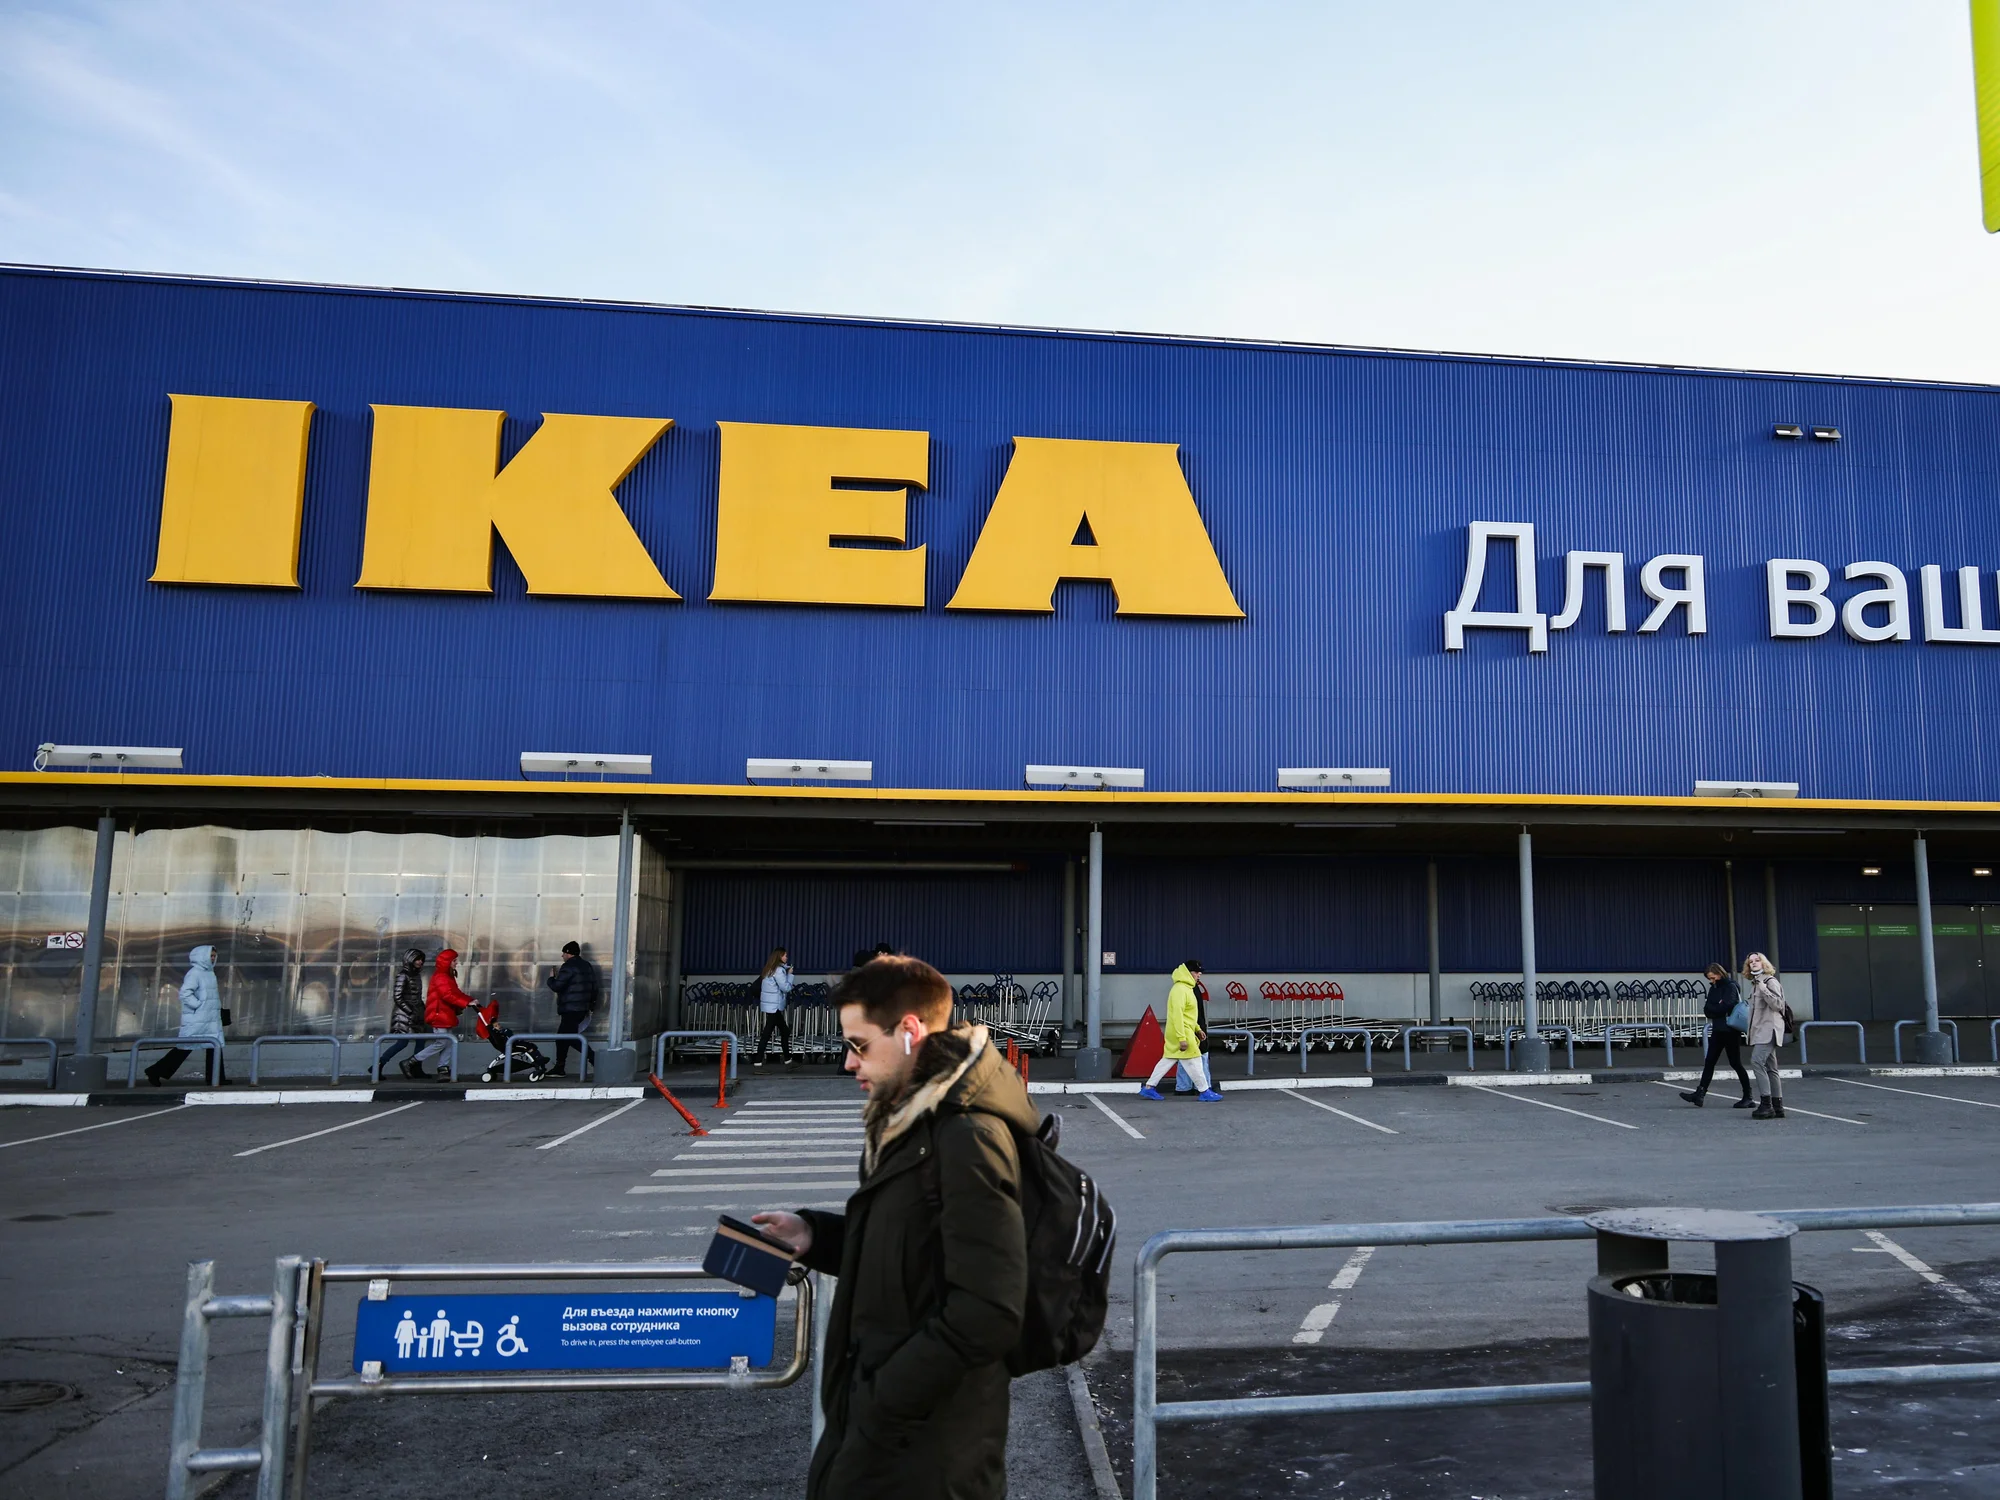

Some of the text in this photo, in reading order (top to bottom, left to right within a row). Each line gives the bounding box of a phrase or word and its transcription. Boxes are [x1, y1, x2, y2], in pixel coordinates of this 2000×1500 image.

[149, 394, 1244, 618] IKEA
[1445, 520, 1707, 653] Для
[562, 1307, 740, 1319] Для въезда нажмите кнопку
[562, 1321, 680, 1333] вызова сотрудника
[588, 1339, 597, 1347] in,
[618, 1338, 630, 1346] the
[631, 1338, 664, 1347] employee
[665, 1338, 701, 1346] call-button
